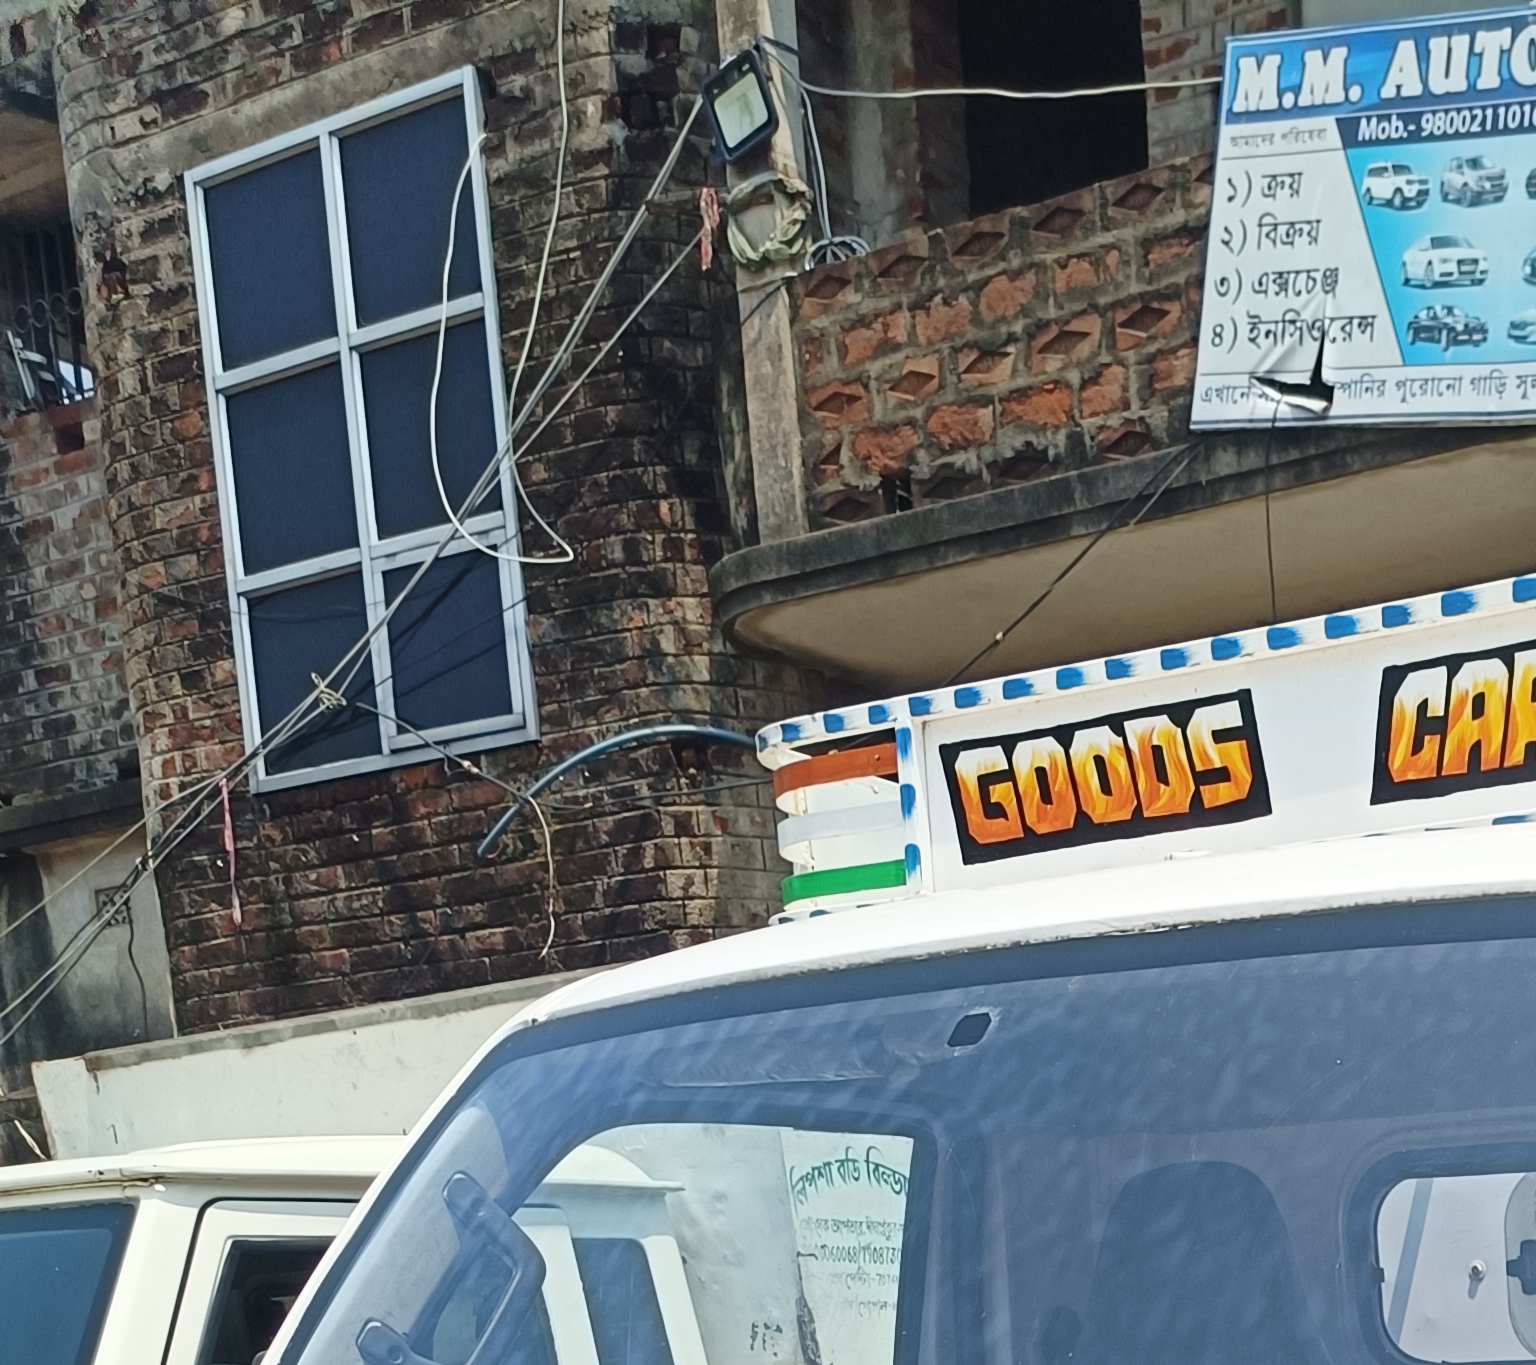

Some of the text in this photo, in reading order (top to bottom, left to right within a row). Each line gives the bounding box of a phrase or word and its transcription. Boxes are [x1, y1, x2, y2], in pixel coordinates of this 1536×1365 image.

[1231, 46, 1363, 114] M.M.
[1261, 172, 1304, 202] ক্রয়
[1257, 212, 1323, 251] বিক্রয়
[1469, 369, 1508, 400] গাড়ি
[955, 699, 1253, 846] GOODS
